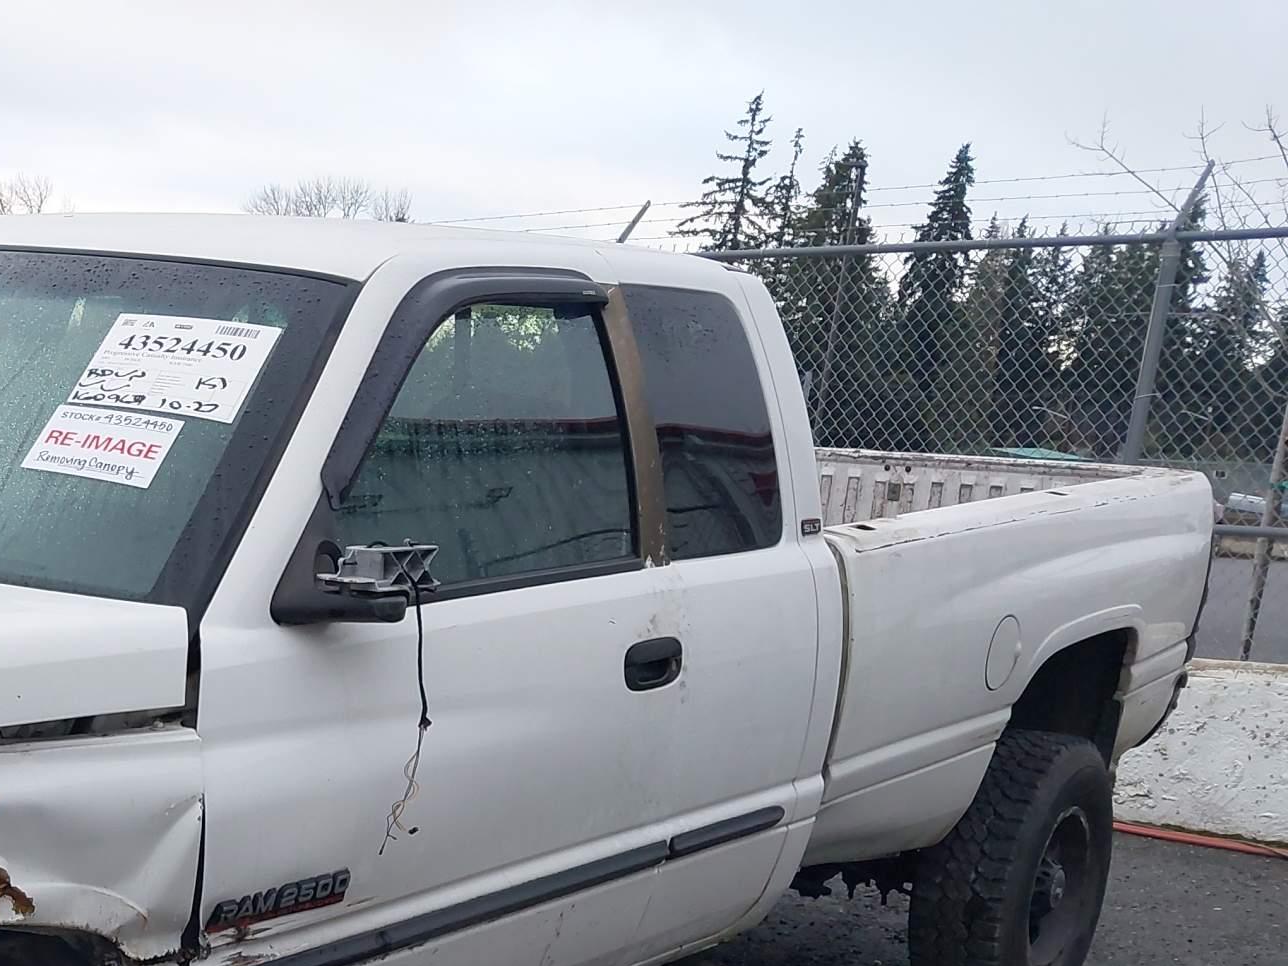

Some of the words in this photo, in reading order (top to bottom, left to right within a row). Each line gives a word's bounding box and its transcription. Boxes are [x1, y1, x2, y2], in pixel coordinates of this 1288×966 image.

[118, 334, 248, 361] 43524450
[103, 413, 174, 432] 43524450
[44, 429, 162, 460] RE-IMAGE
[36, 450, 87, 471] Removing
[88, 456, 138, 481] Canopy
[803, 522, 820, 533] SLT
